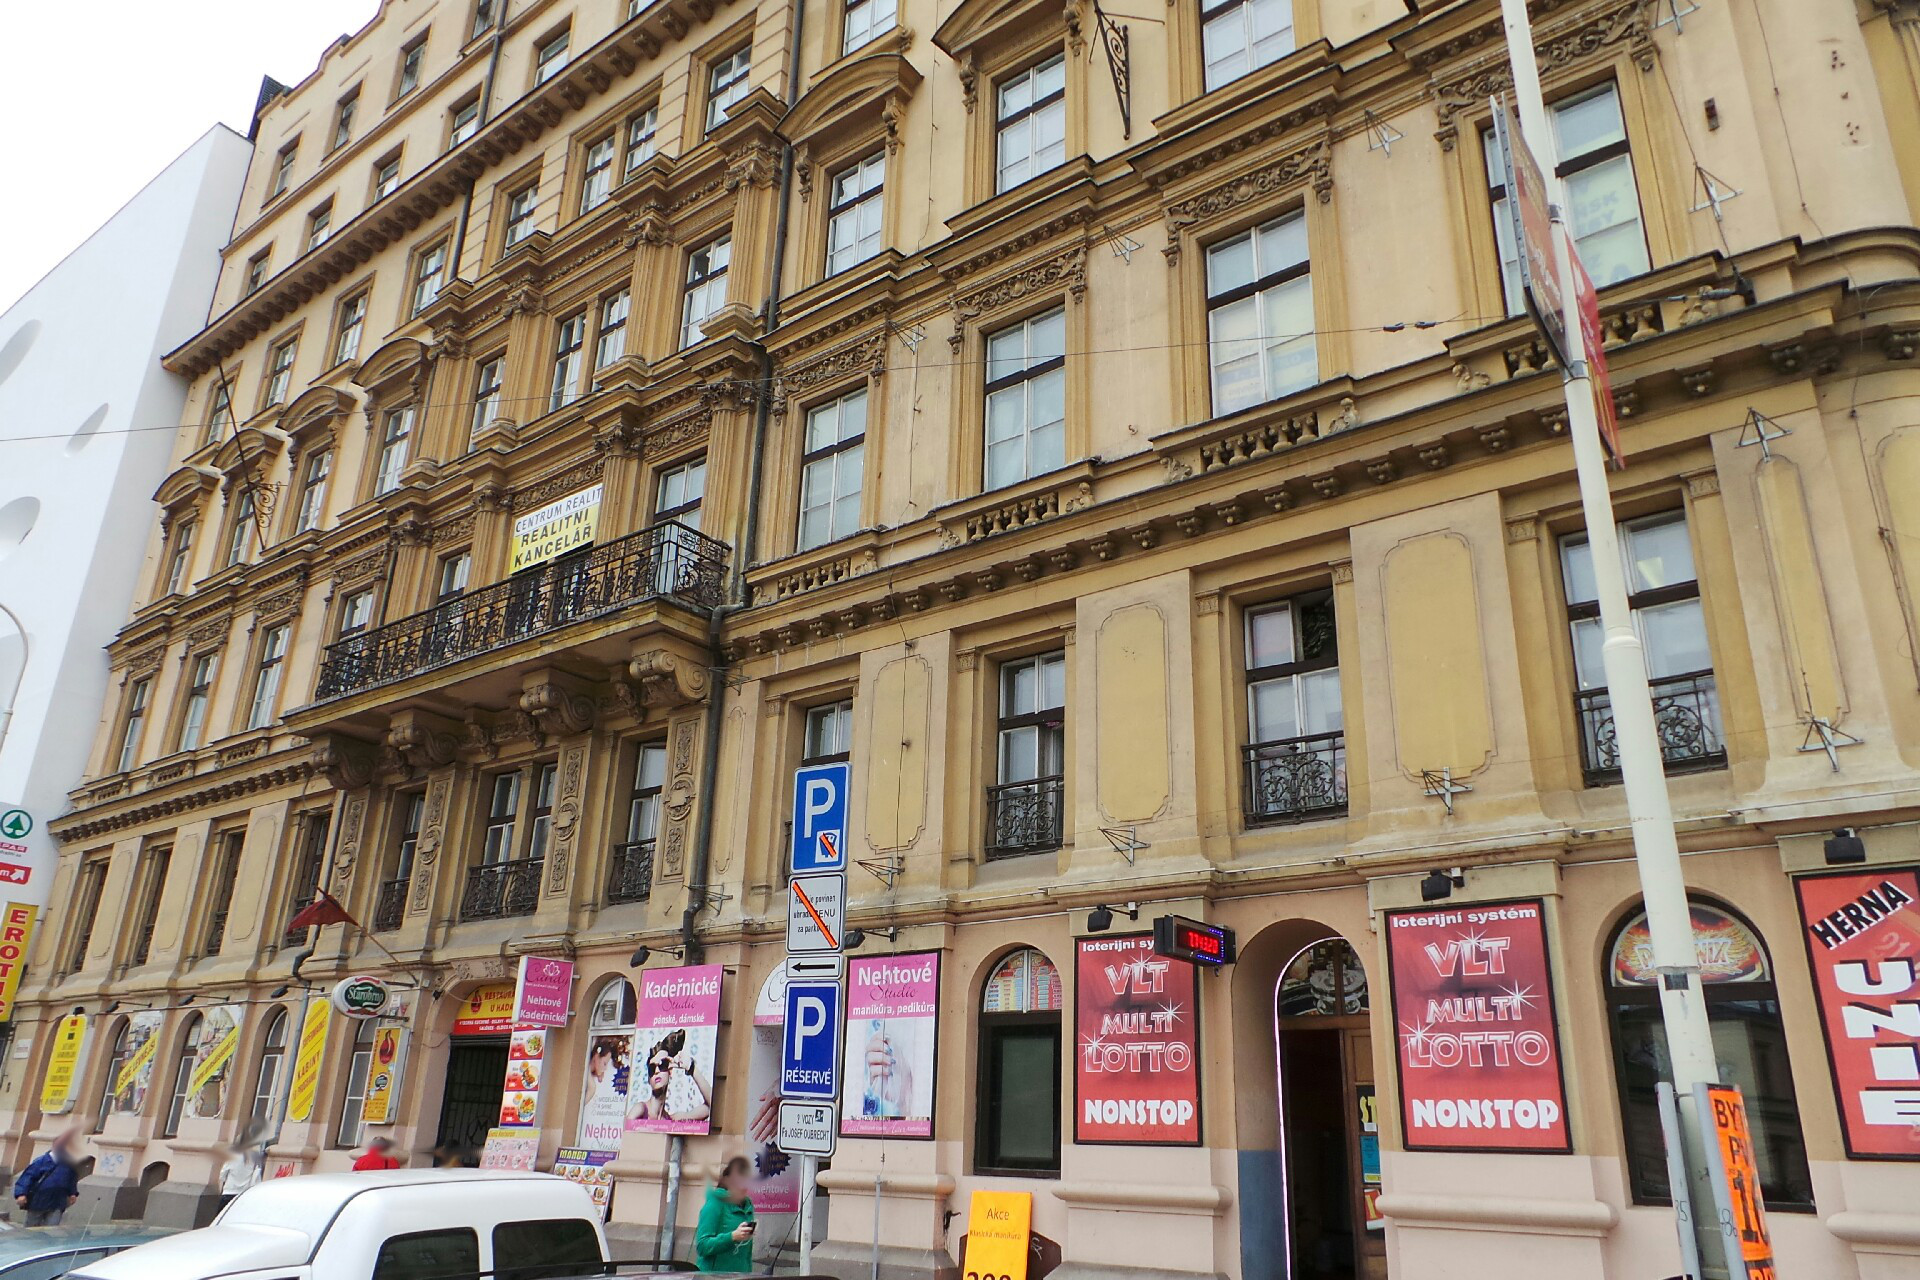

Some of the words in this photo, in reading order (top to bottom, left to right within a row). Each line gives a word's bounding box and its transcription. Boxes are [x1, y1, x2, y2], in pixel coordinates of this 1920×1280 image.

[515, 505, 562, 532] CENTRUM
[514, 523, 592, 568] KANCELÁŘ
[804, 778, 836, 838] P
[0, 842, 26, 852] PAR
[1393, 911, 1463, 928] loterijní
[1467, 907, 1537, 924] systém
[1810, 880, 1914, 950] HERNA
[1083, 939, 1135, 952] loterijní
[1423, 936, 1511, 977] VLT
[858, 961, 932, 986] Nehtové
[1104, 960, 1170, 995] VLT
[347, 984, 385, 1003] Starobrno
[645, 975, 718, 999] Kadeřnické
[526, 994, 562, 1007] Nehtové
[852, 1003, 895, 1016] manikúra,
[896, 1001, 936, 1015] pedikúra
[1425, 996, 1523, 1023] MULTI
[520, 1009, 567, 1022] Kadeřnické
[653, 1014, 678, 1027] pánské,
[679, 1013, 705, 1023] dámské
[1100, 1011, 1173, 1034] MULTI
[795, 996, 827, 1060] P
[1084, 1041, 1191, 1072] LOTTO
[1407, 1031, 1550, 1068] LOTTO
[785, 1067, 832, 1085] RÉSERVÉ
[802, 1114, 815, 1125] VOZY
[1084, 1099, 1194, 1125] NONSTOP
[1411, 1098, 1559, 1129] NONSTOP
[788, 1127, 803, 1139] JOSEF
[559, 1149, 588, 1160] MANGO
[986, 1206, 1010, 1221] Akce
